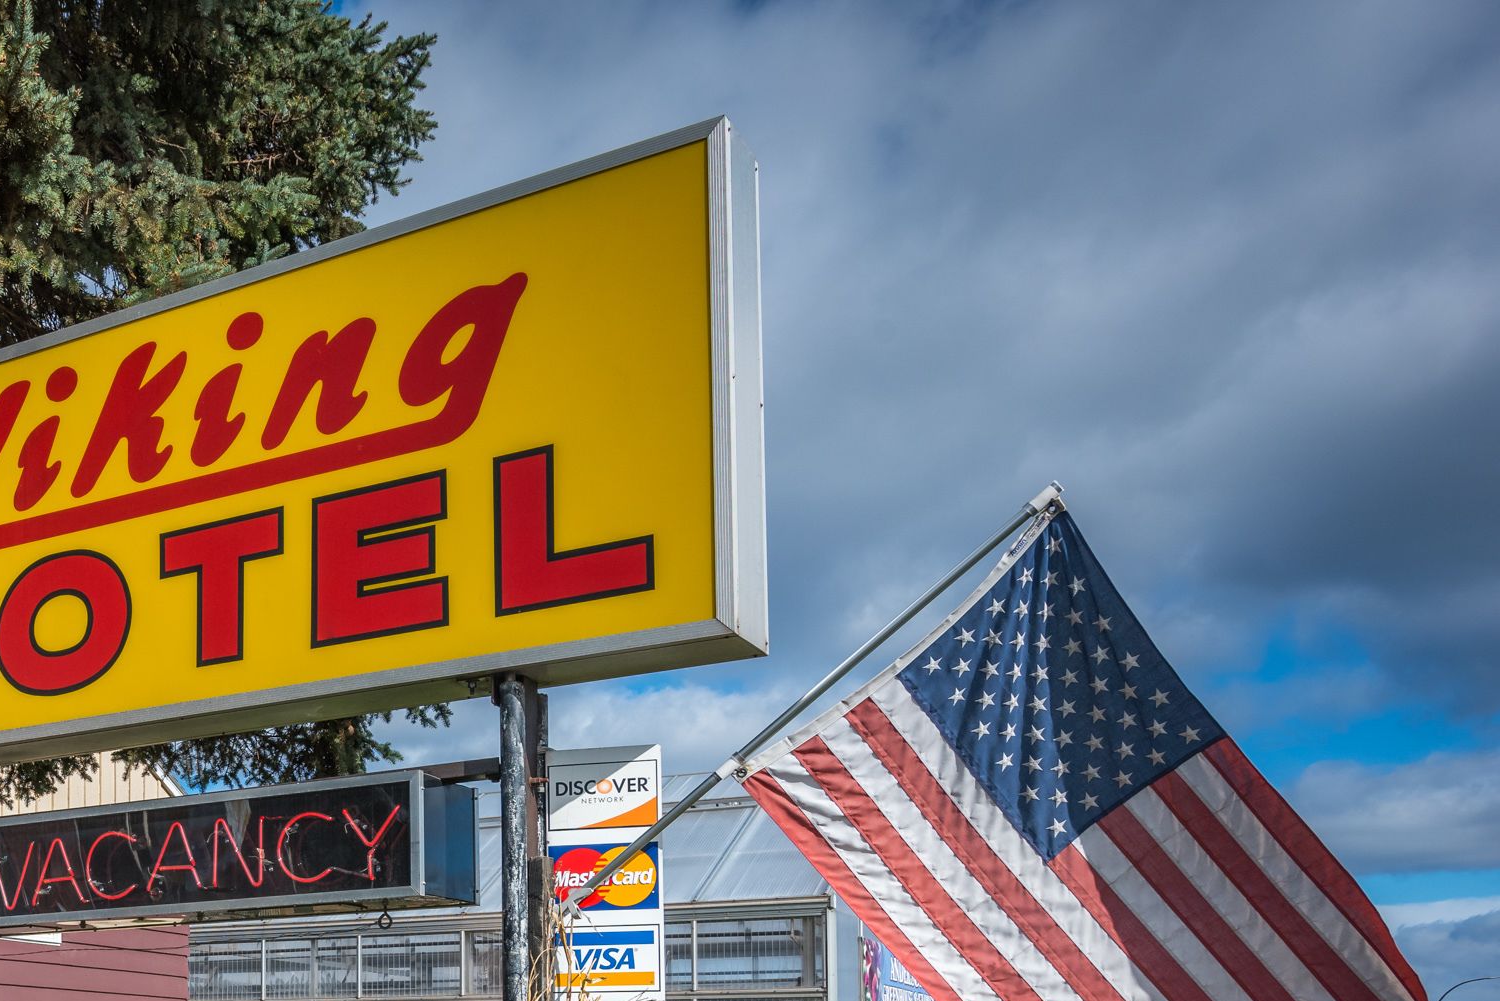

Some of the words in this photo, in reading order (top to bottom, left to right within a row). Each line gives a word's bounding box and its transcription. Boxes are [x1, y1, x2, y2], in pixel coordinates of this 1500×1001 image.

[555, 777, 649, 797] DISCOVER
[581, 796, 624, 804] NETWORK
[554, 867, 654, 888] MastrCard
[572, 947, 636, 971] VISA
